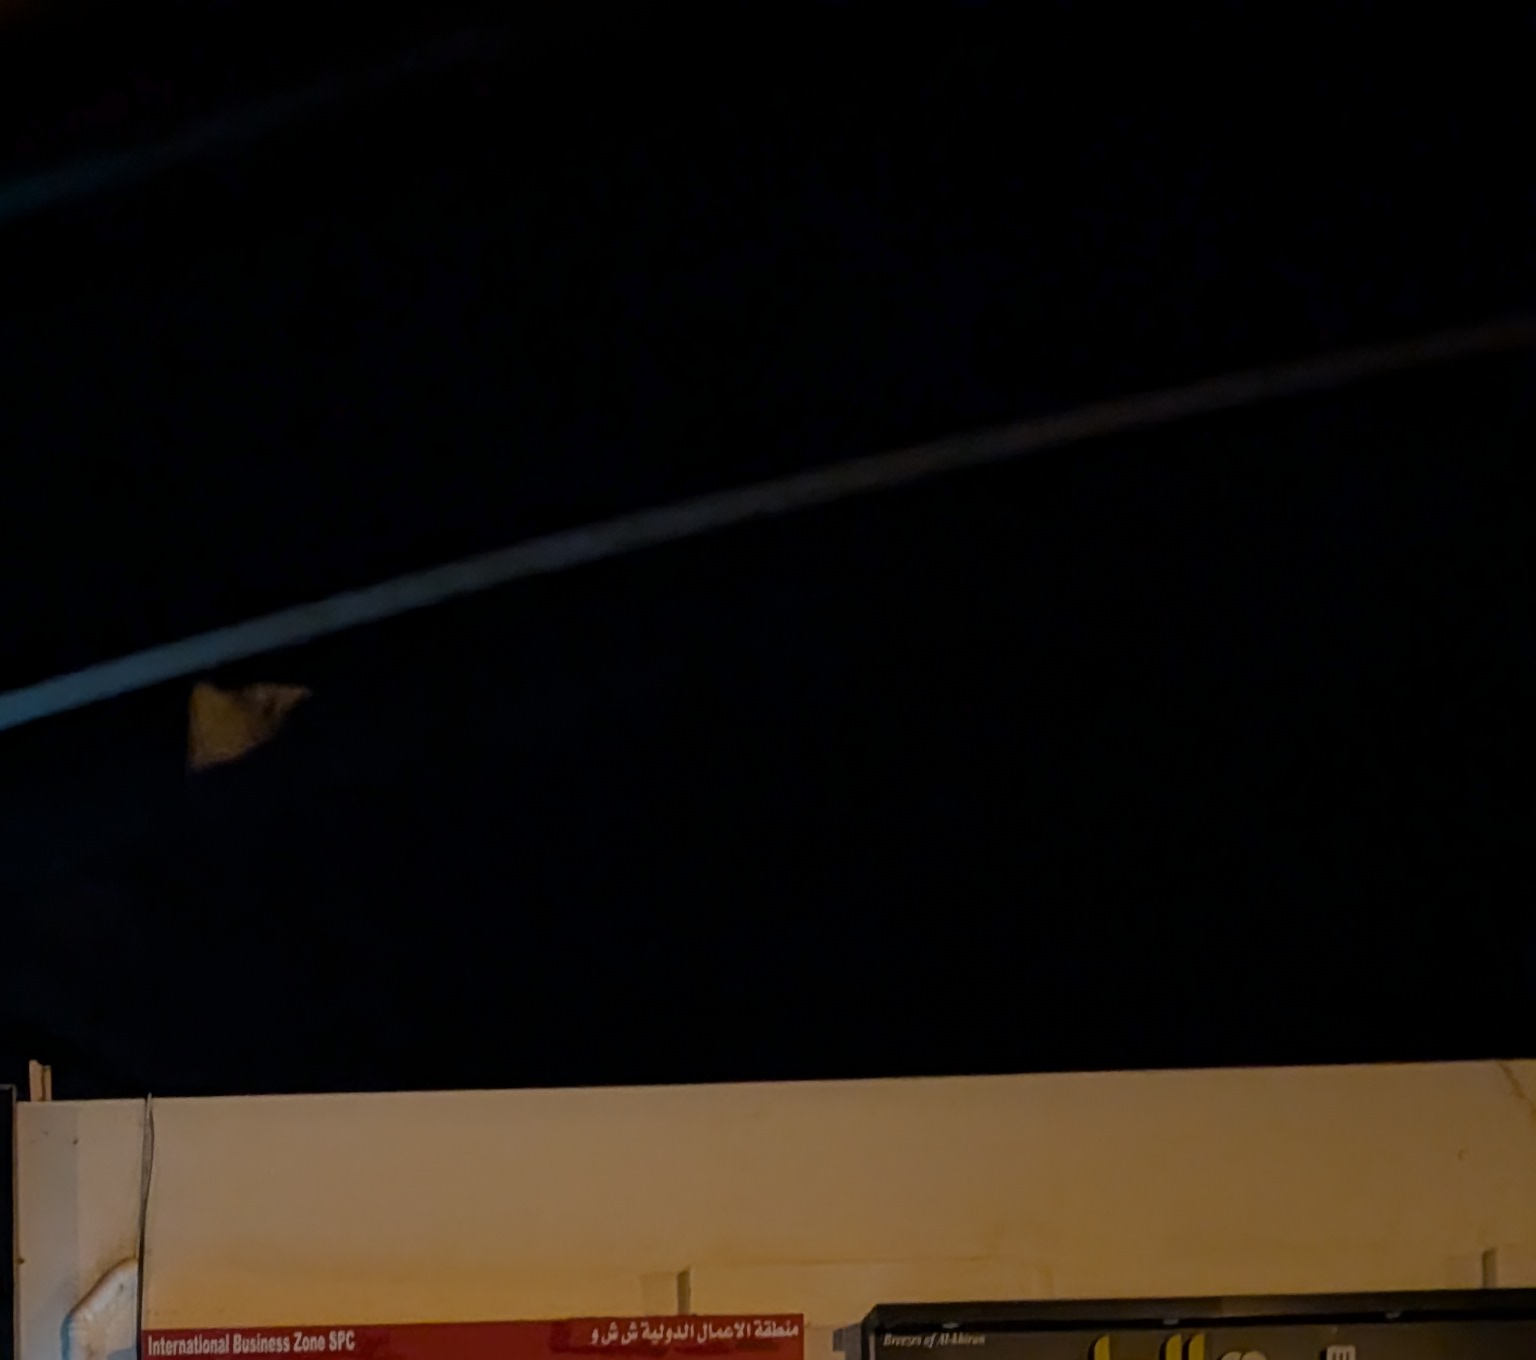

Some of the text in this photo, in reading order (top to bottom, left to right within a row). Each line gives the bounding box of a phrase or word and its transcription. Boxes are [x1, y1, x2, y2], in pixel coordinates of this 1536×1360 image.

[640, 1320, 695, 1347] الدولية
[754, 1318, 799, 1339] منطقة
[148, 1330, 356, 1356] International Business Zone SPC
